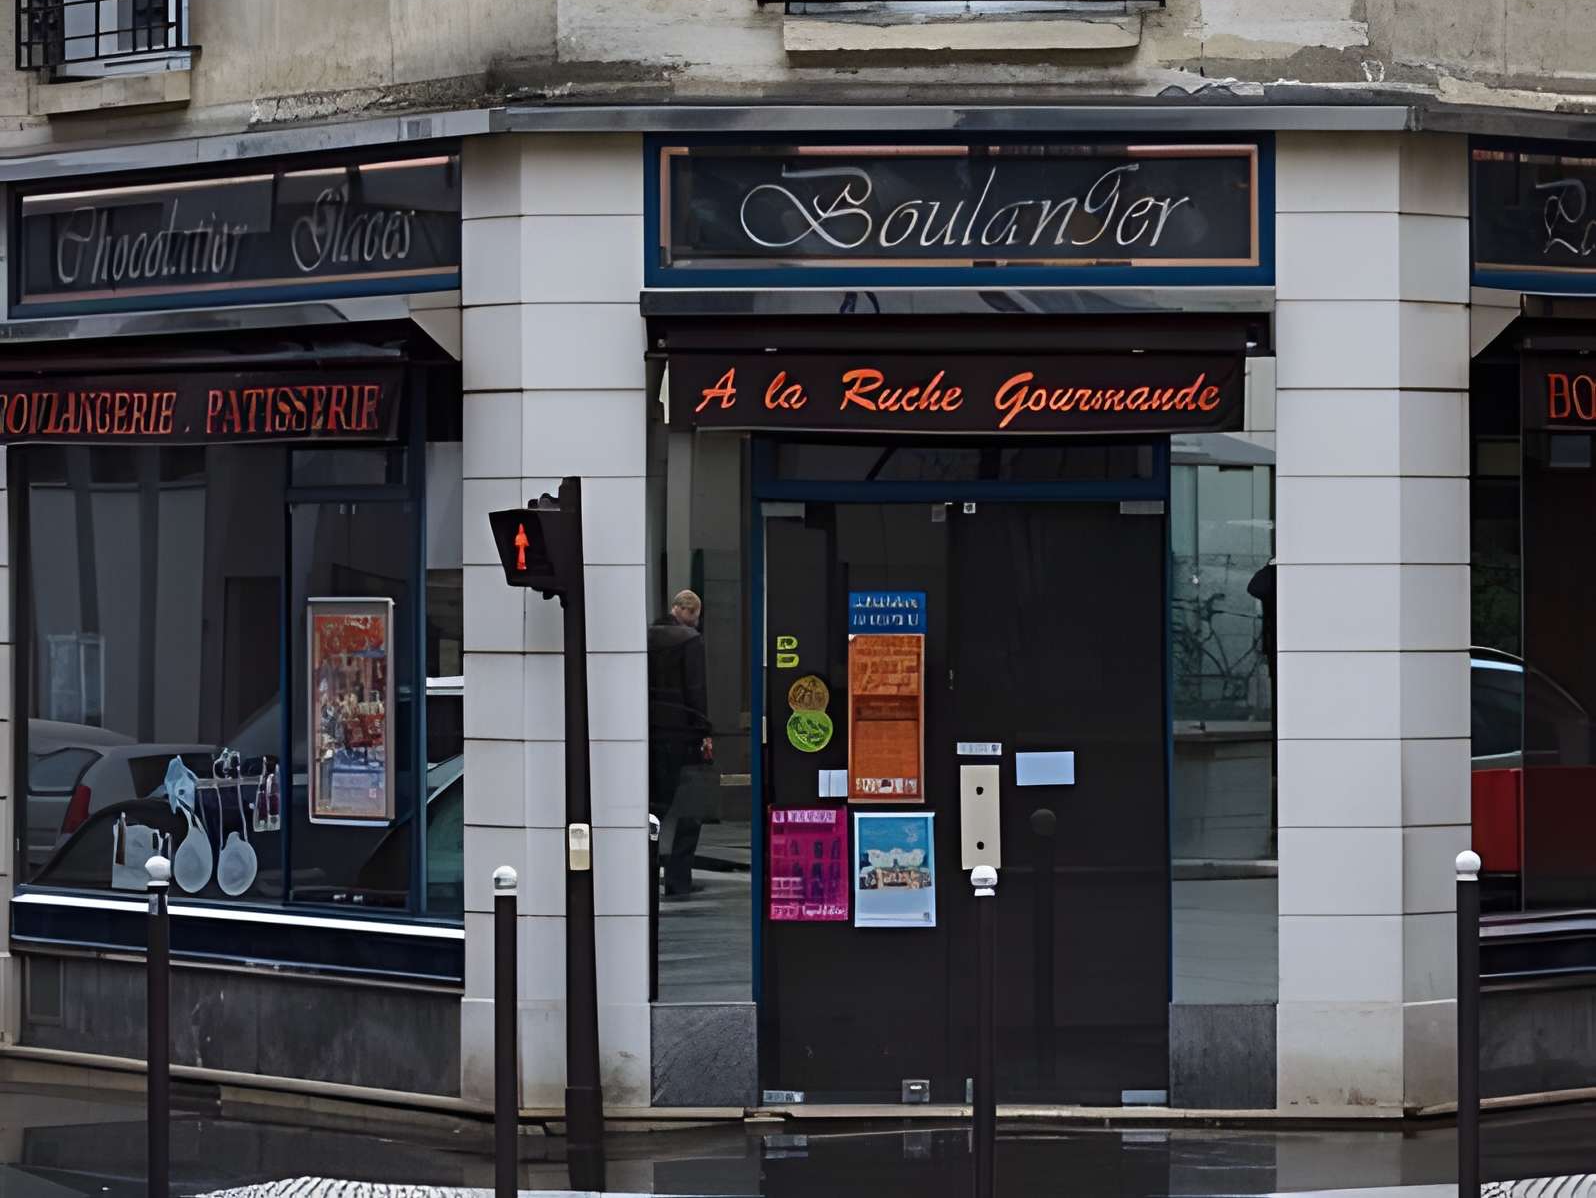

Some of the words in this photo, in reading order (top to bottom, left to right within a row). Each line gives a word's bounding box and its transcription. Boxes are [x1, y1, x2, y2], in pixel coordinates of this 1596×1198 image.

[205, 384, 382, 434] PATISSERIE
[696, 367, 736, 413] A
[765, 370, 808, 410] la
[840, 368, 964, 413] Ruche
[995, 371, 1221, 429] Gourmande
[1547, 372, 1596, 421] BO
